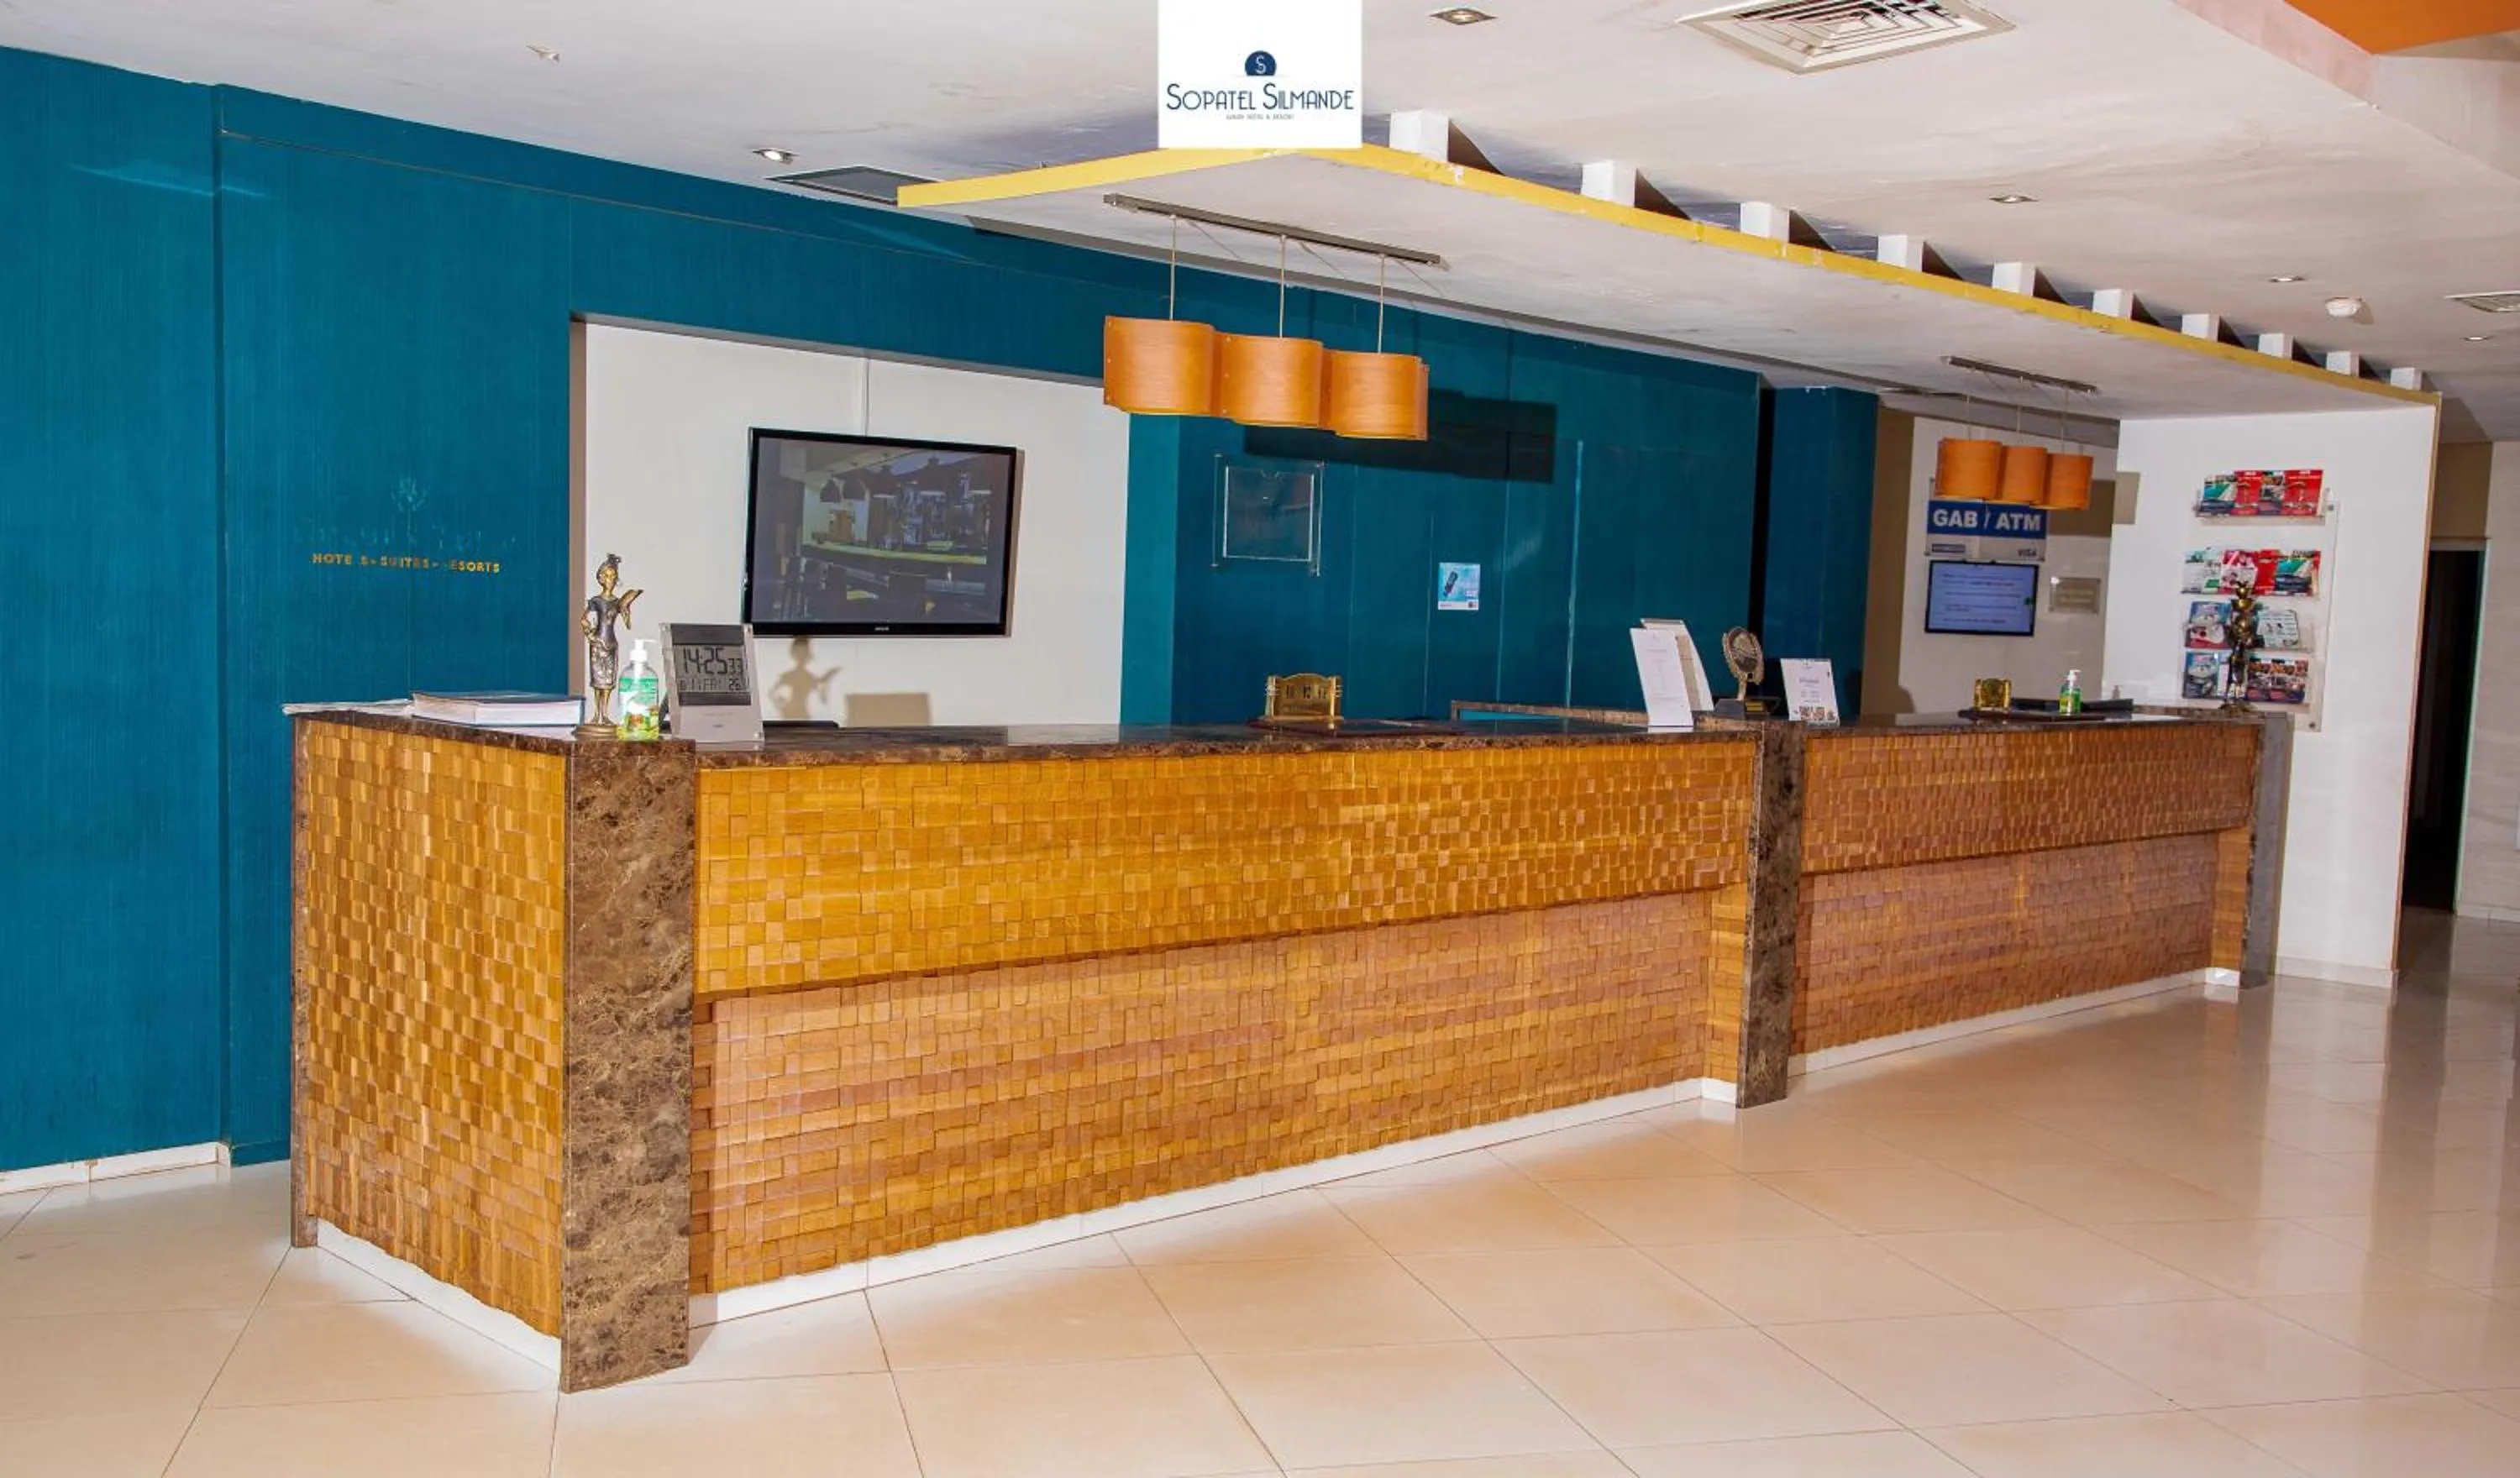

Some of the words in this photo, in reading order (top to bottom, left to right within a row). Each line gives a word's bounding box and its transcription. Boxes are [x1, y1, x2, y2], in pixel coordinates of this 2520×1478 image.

[1933, 508, 1978, 528] GAB
[1995, 512, 2041, 531] ATM
[450, 559, 501, 574] ESORTS
